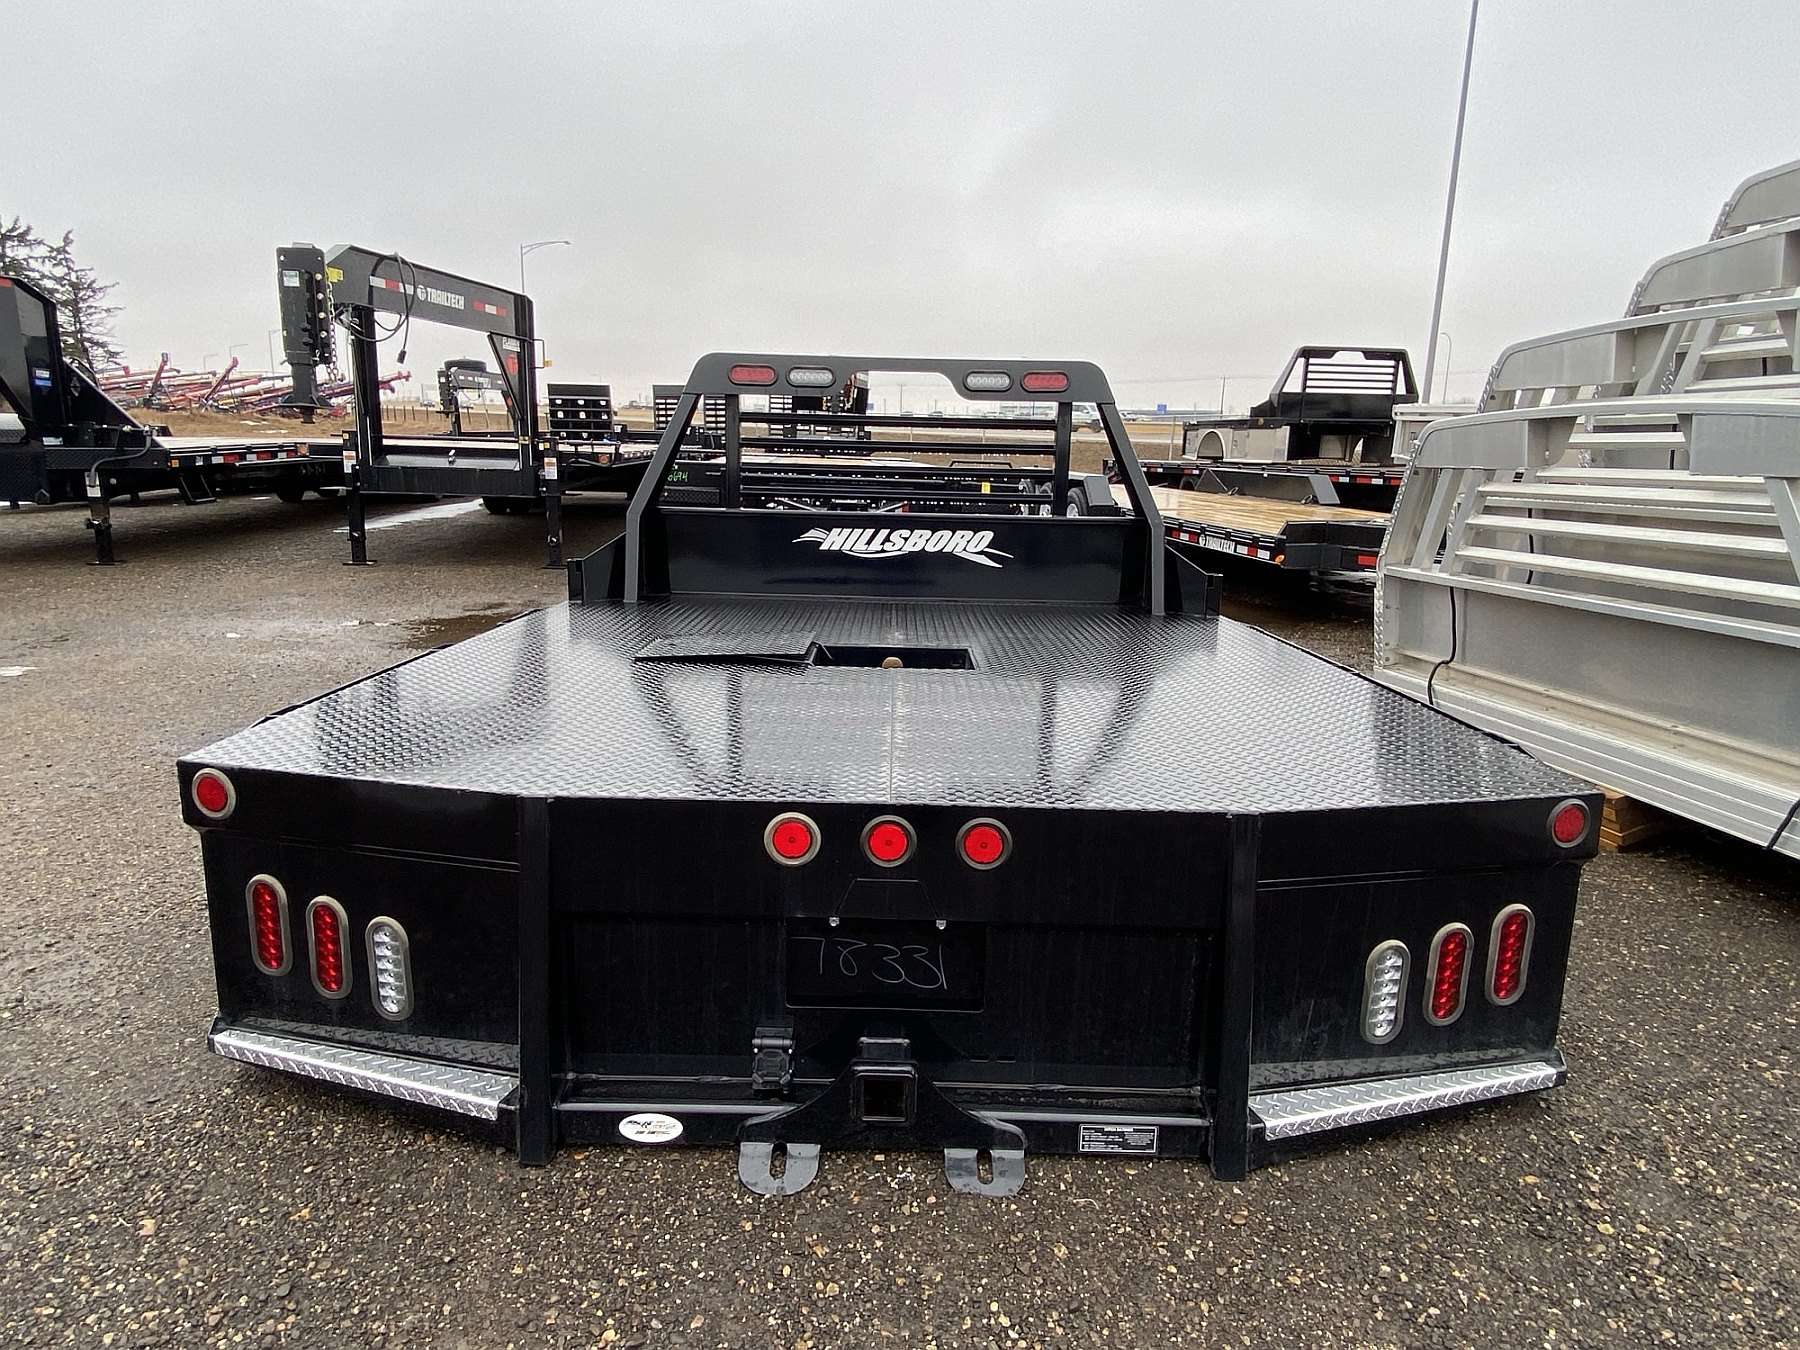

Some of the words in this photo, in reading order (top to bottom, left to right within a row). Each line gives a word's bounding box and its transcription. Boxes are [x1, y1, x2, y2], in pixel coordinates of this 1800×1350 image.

[427, 287, 465, 310] TRAILTECH
[818, 527, 995, 553] HILLSBORO
[791, 936, 947, 989] 78331
